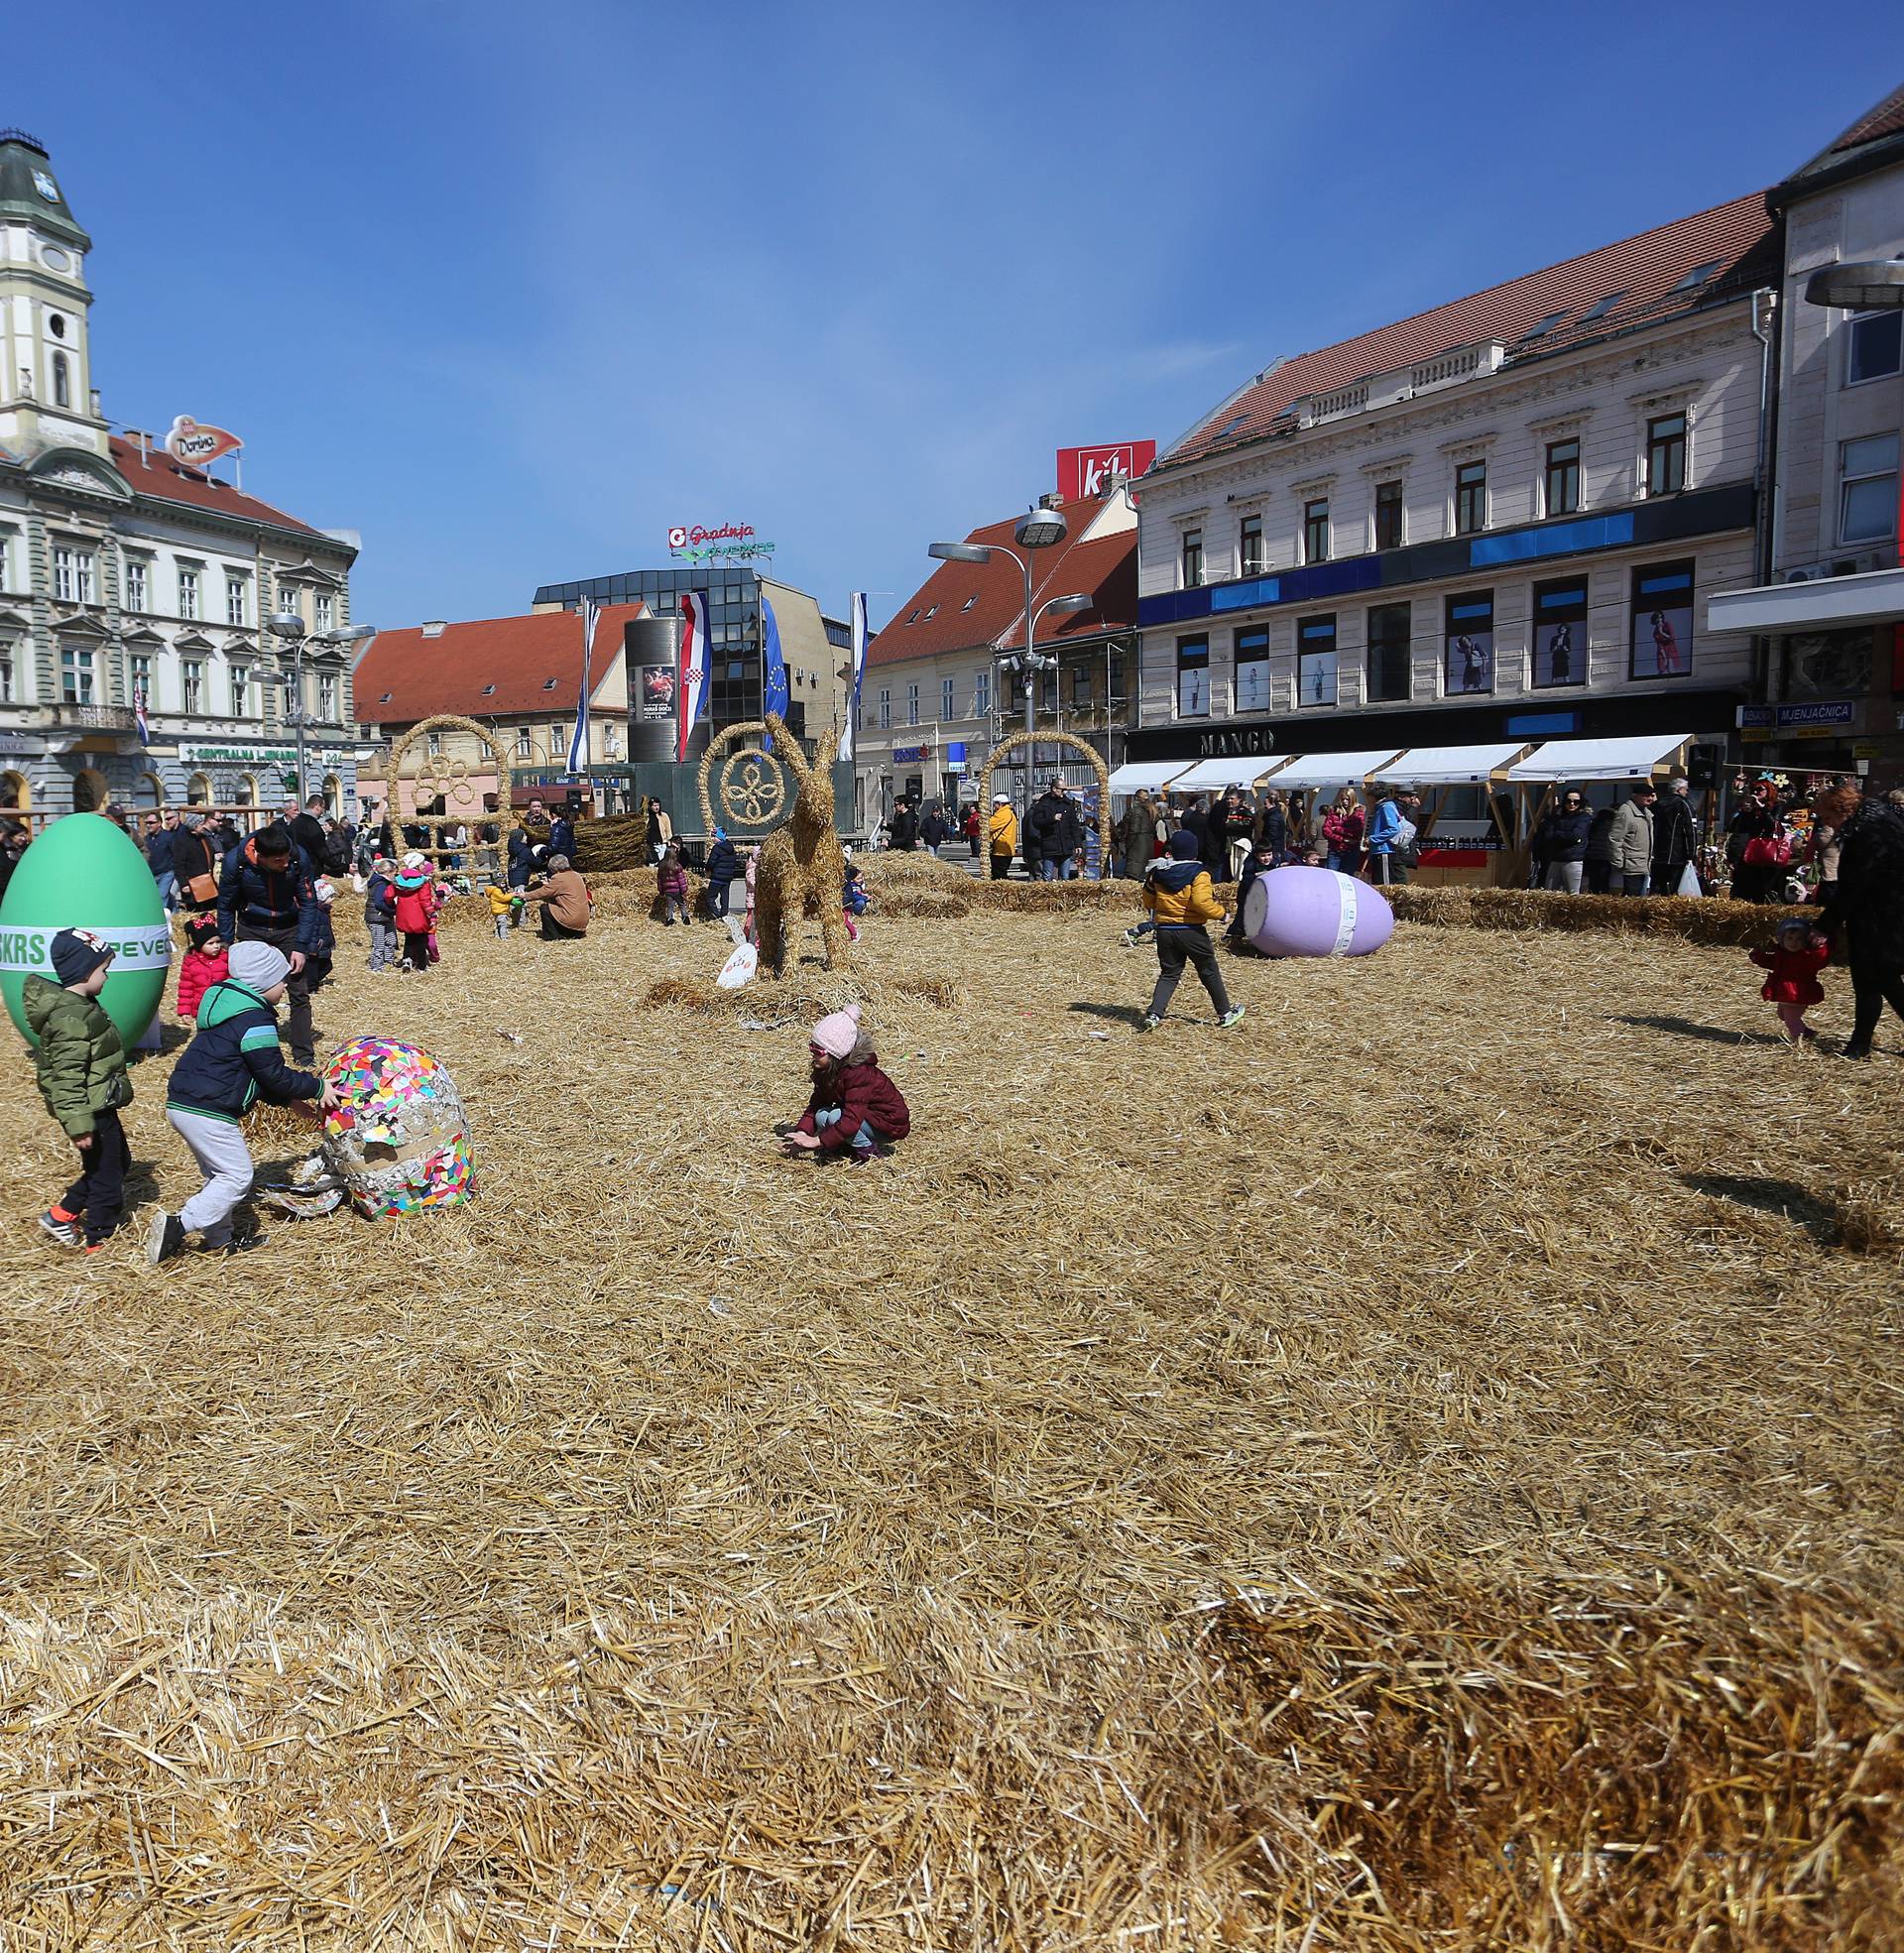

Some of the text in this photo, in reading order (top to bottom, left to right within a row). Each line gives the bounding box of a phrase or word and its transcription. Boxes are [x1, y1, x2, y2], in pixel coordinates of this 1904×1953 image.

[177, 435, 215, 455] Dorina
[689, 522, 755, 546] Gradnja
[1781, 705, 1849, 720] MJENJAČNICA
[1200, 730, 1274, 755] MANGO
[256, 749, 298, 762] LJEKARN
[0, 933, 46, 965] KRS
